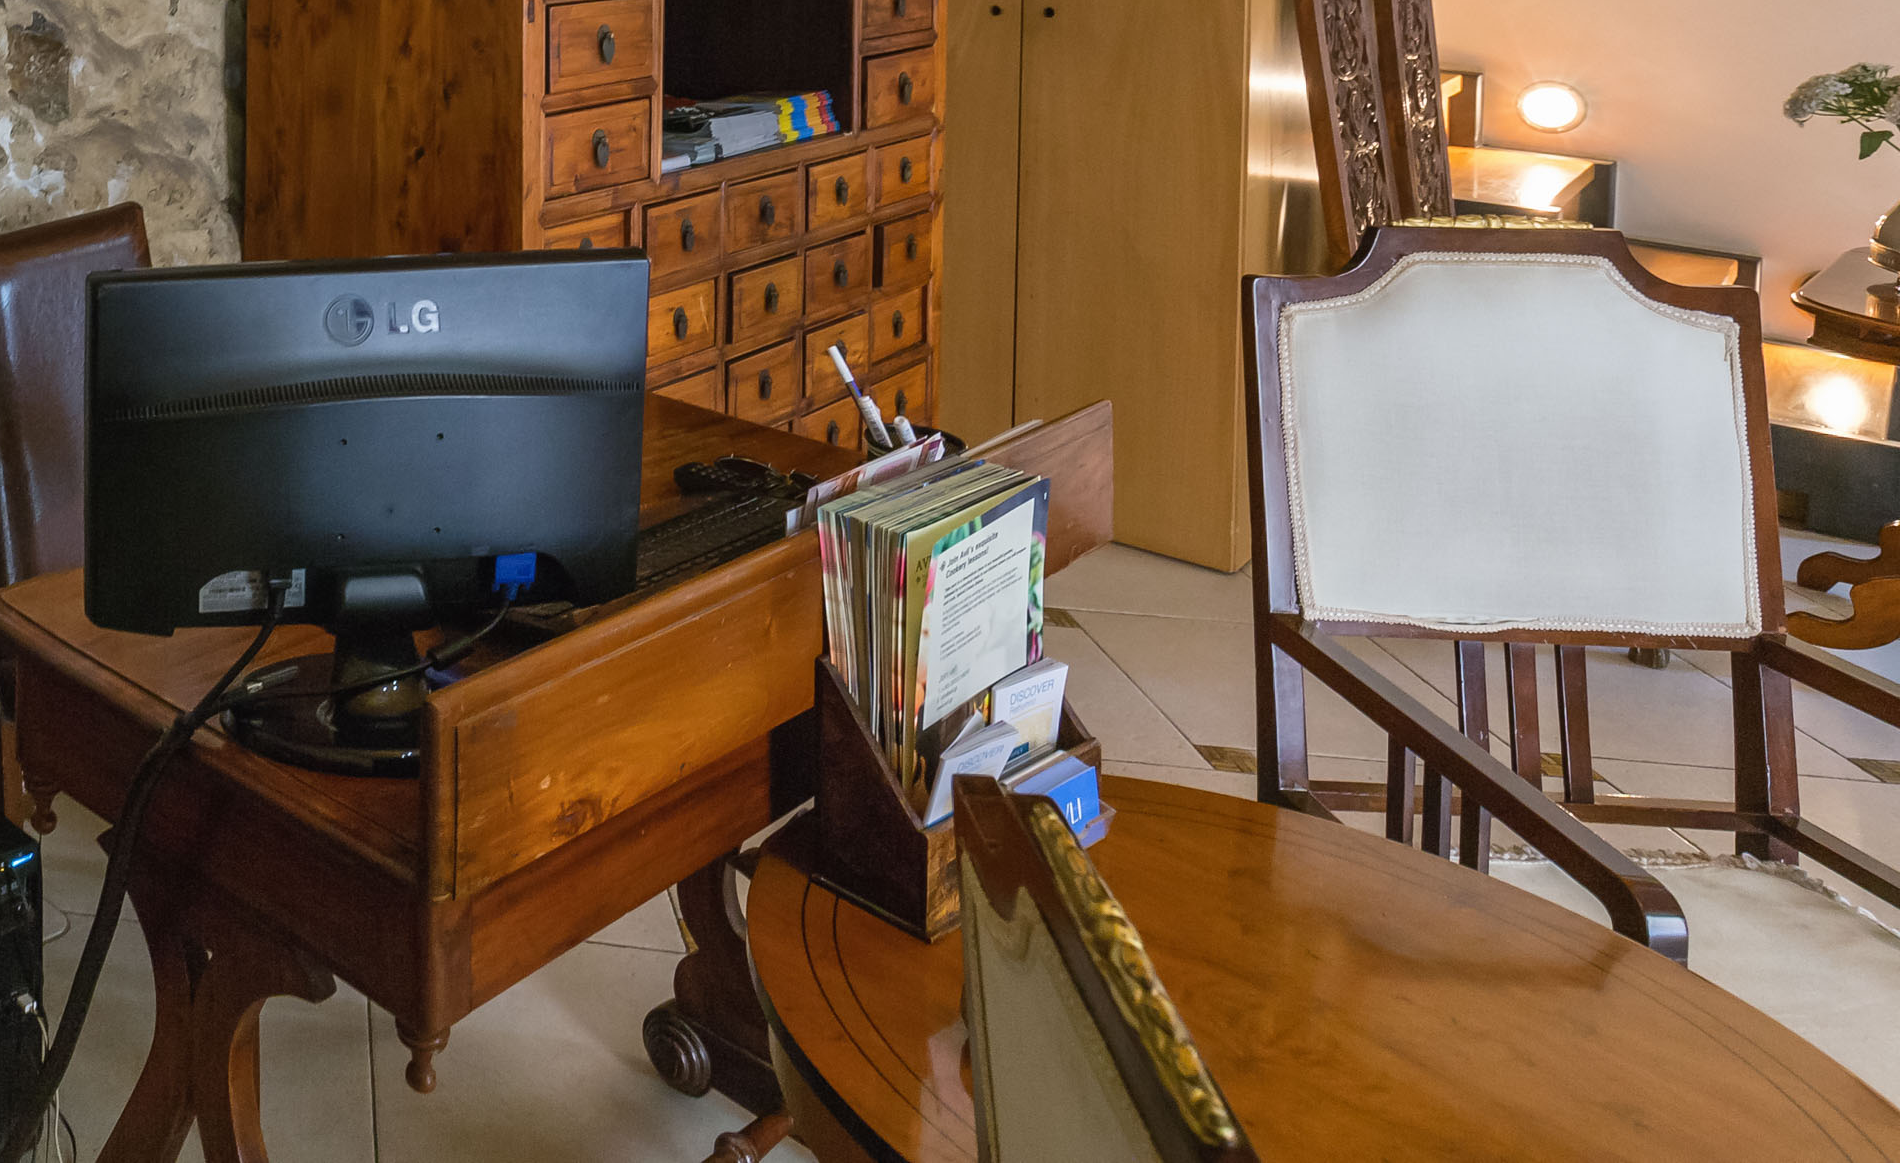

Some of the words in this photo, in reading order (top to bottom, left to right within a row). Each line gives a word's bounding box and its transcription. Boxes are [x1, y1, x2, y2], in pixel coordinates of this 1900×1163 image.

[388, 299, 441, 335] LG
[945, 560, 967, 579] Cookery
[1010, 679, 1054, 705] DISCOVER
